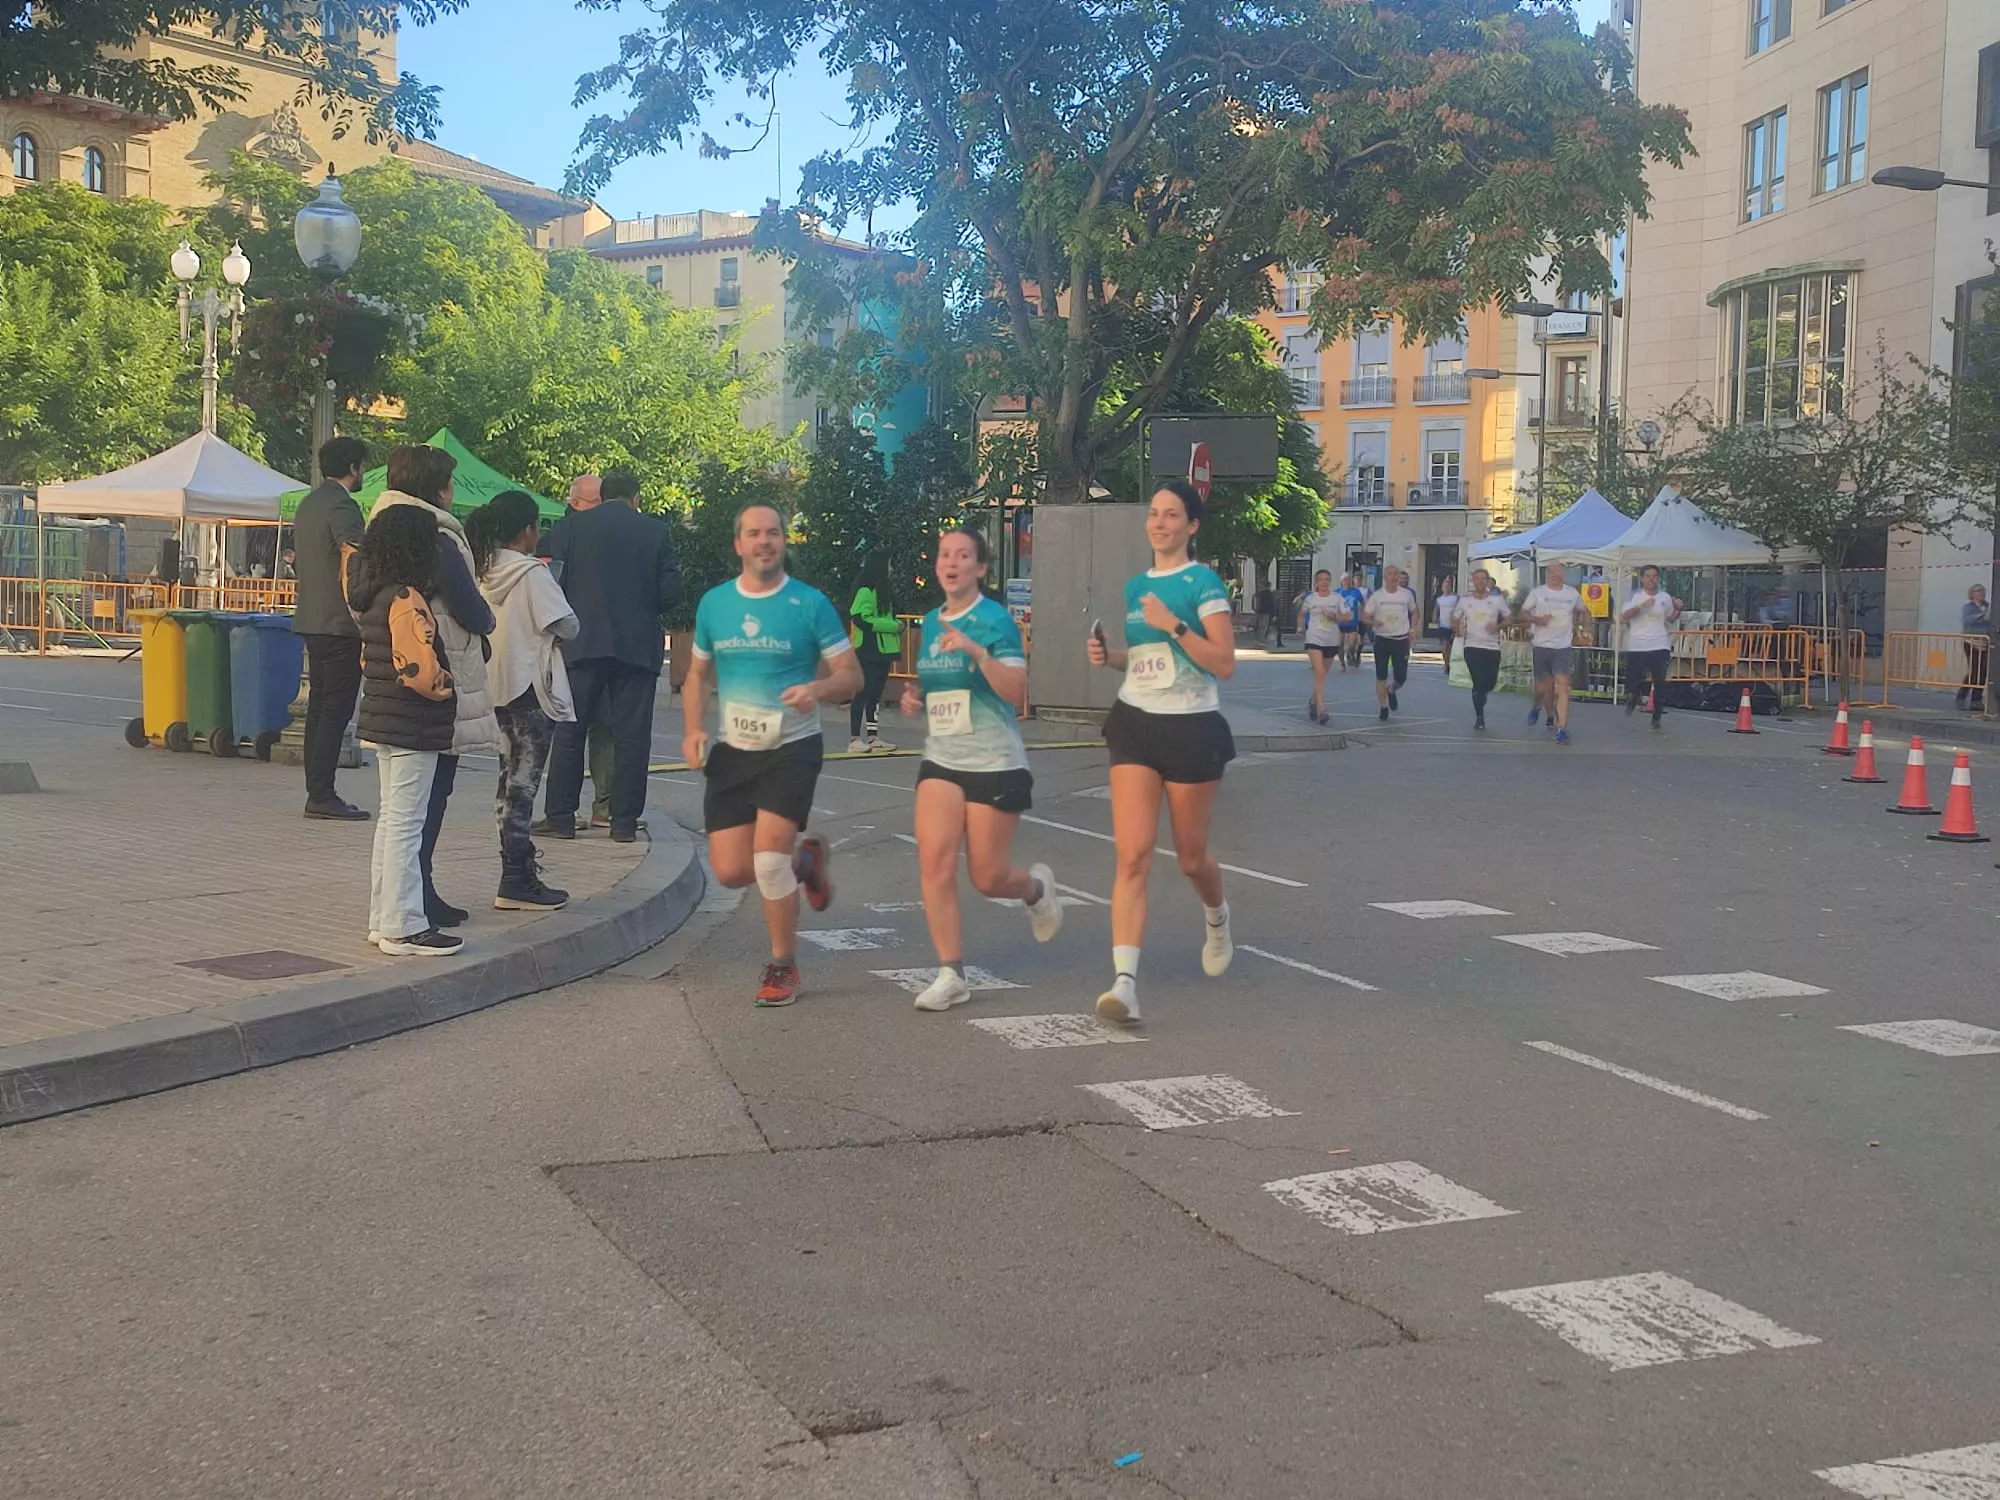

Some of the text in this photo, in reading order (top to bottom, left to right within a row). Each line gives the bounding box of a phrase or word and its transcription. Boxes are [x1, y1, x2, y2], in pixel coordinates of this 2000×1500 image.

[1132, 657, 1166, 674] 4016
[930, 702, 963, 717] 4017
[733, 717, 767, 733] 1051
